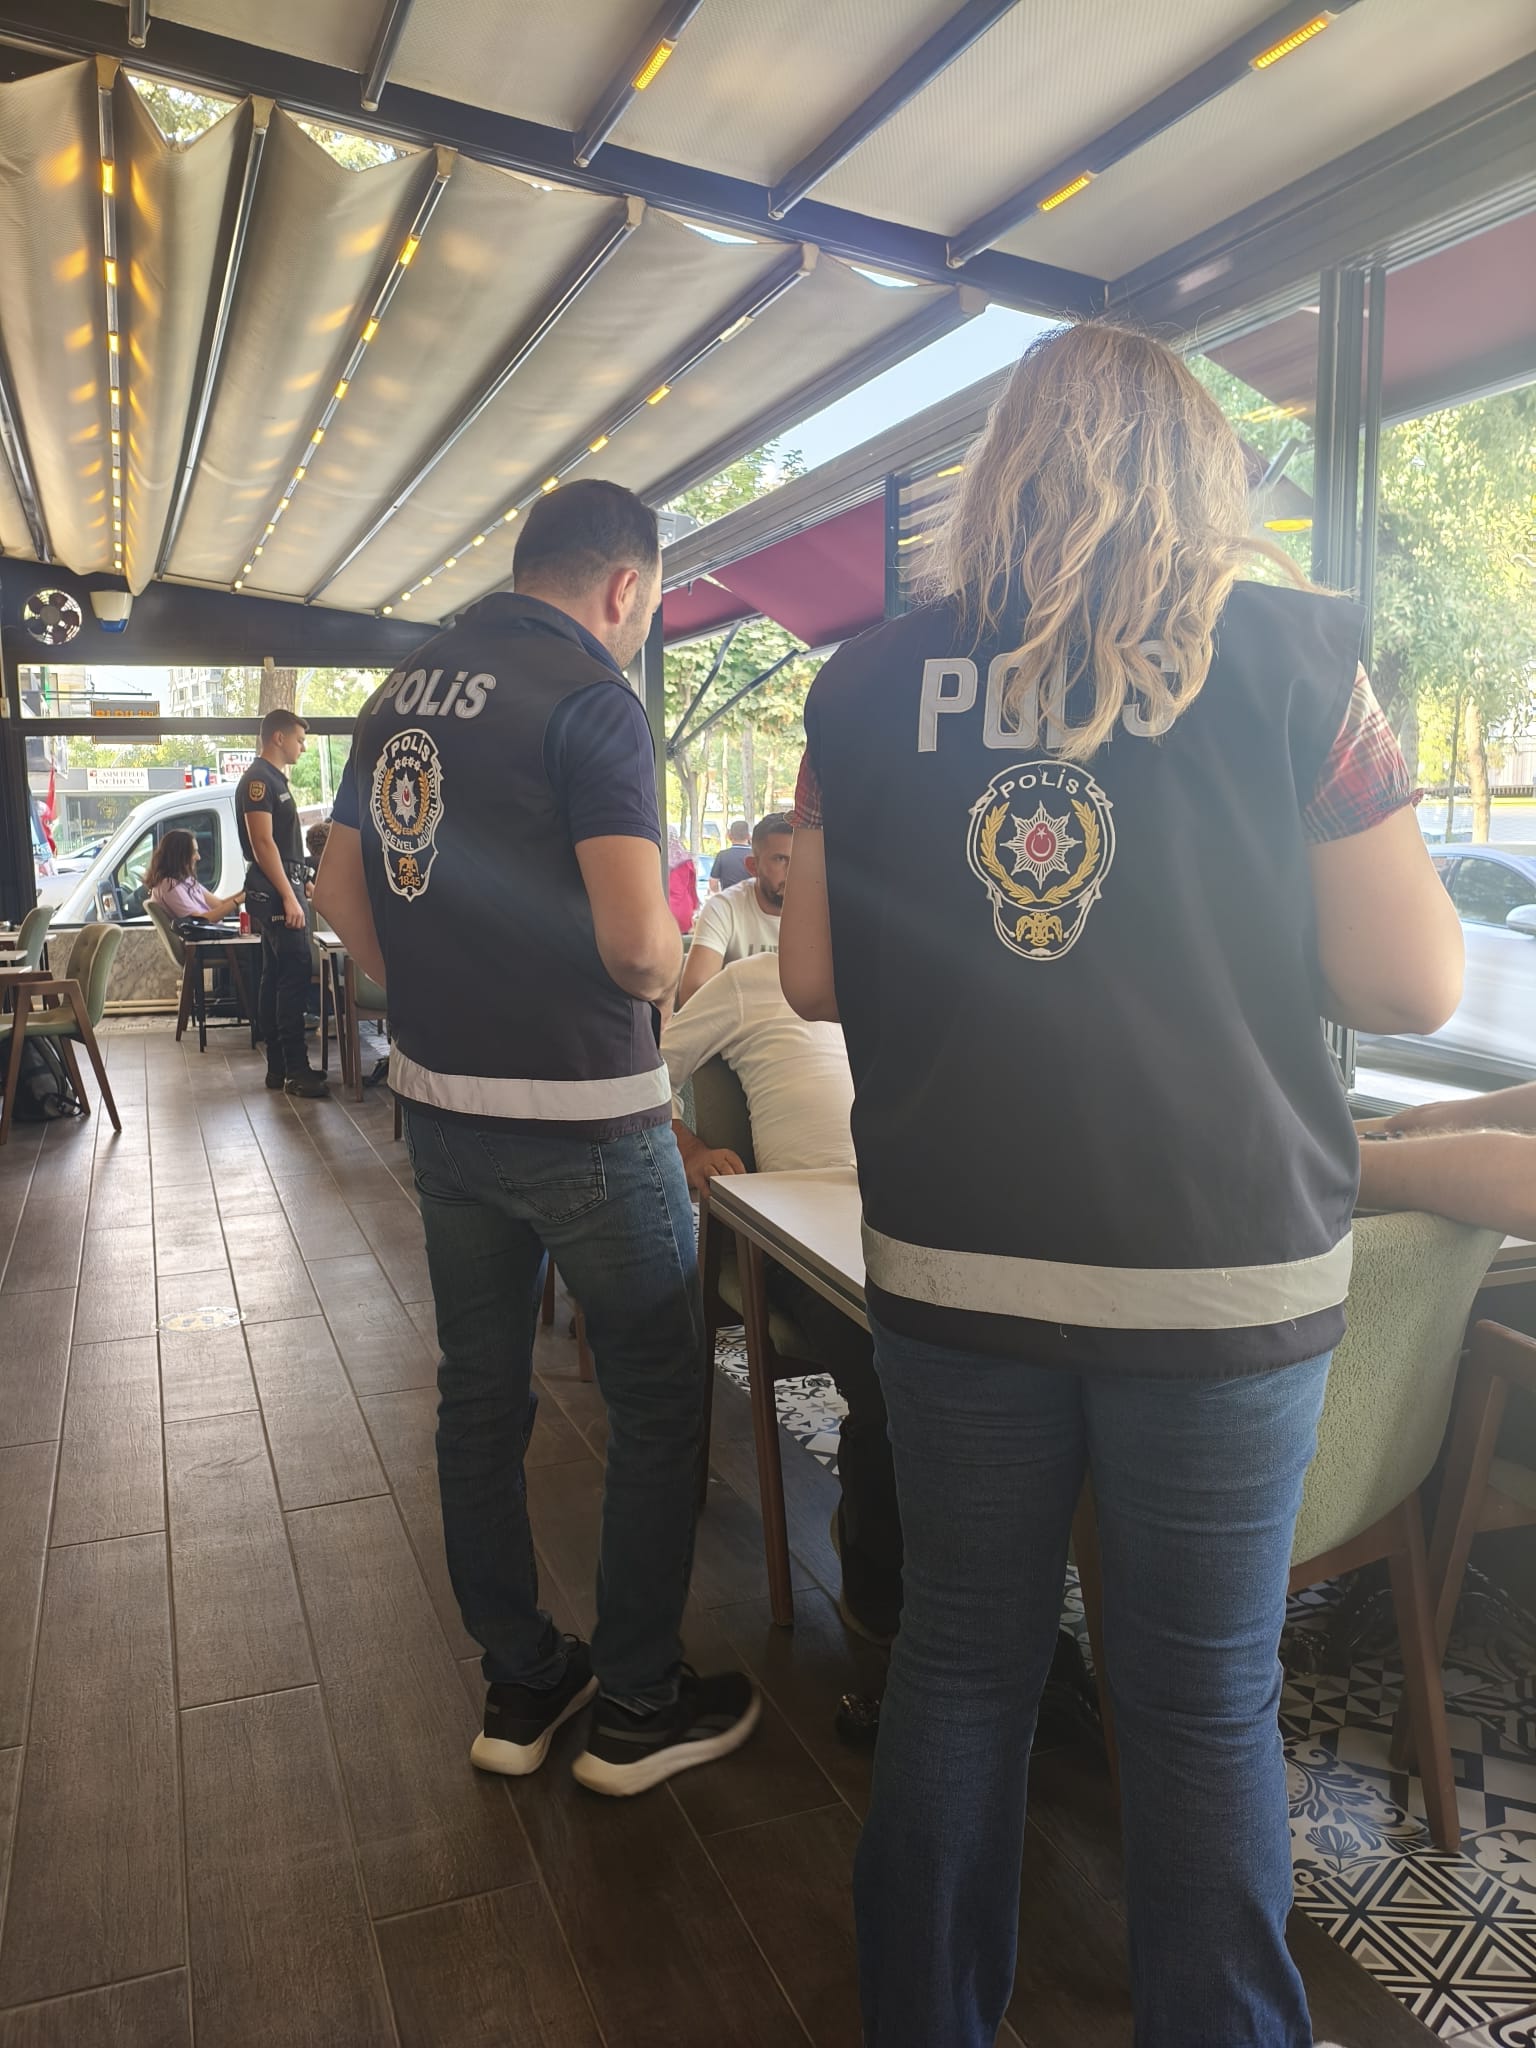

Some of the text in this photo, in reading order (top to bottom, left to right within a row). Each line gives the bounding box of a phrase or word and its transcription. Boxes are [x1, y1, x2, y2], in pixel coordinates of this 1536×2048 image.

[371, 668, 497, 719] POLİS
[918, 640, 1183, 752] POLS
[391, 734, 430, 762] POLİS
[1000, 768, 1079, 799] POLİS
[385, 829, 415, 850] GENEL
[399, 876, 420, 886] 1845
